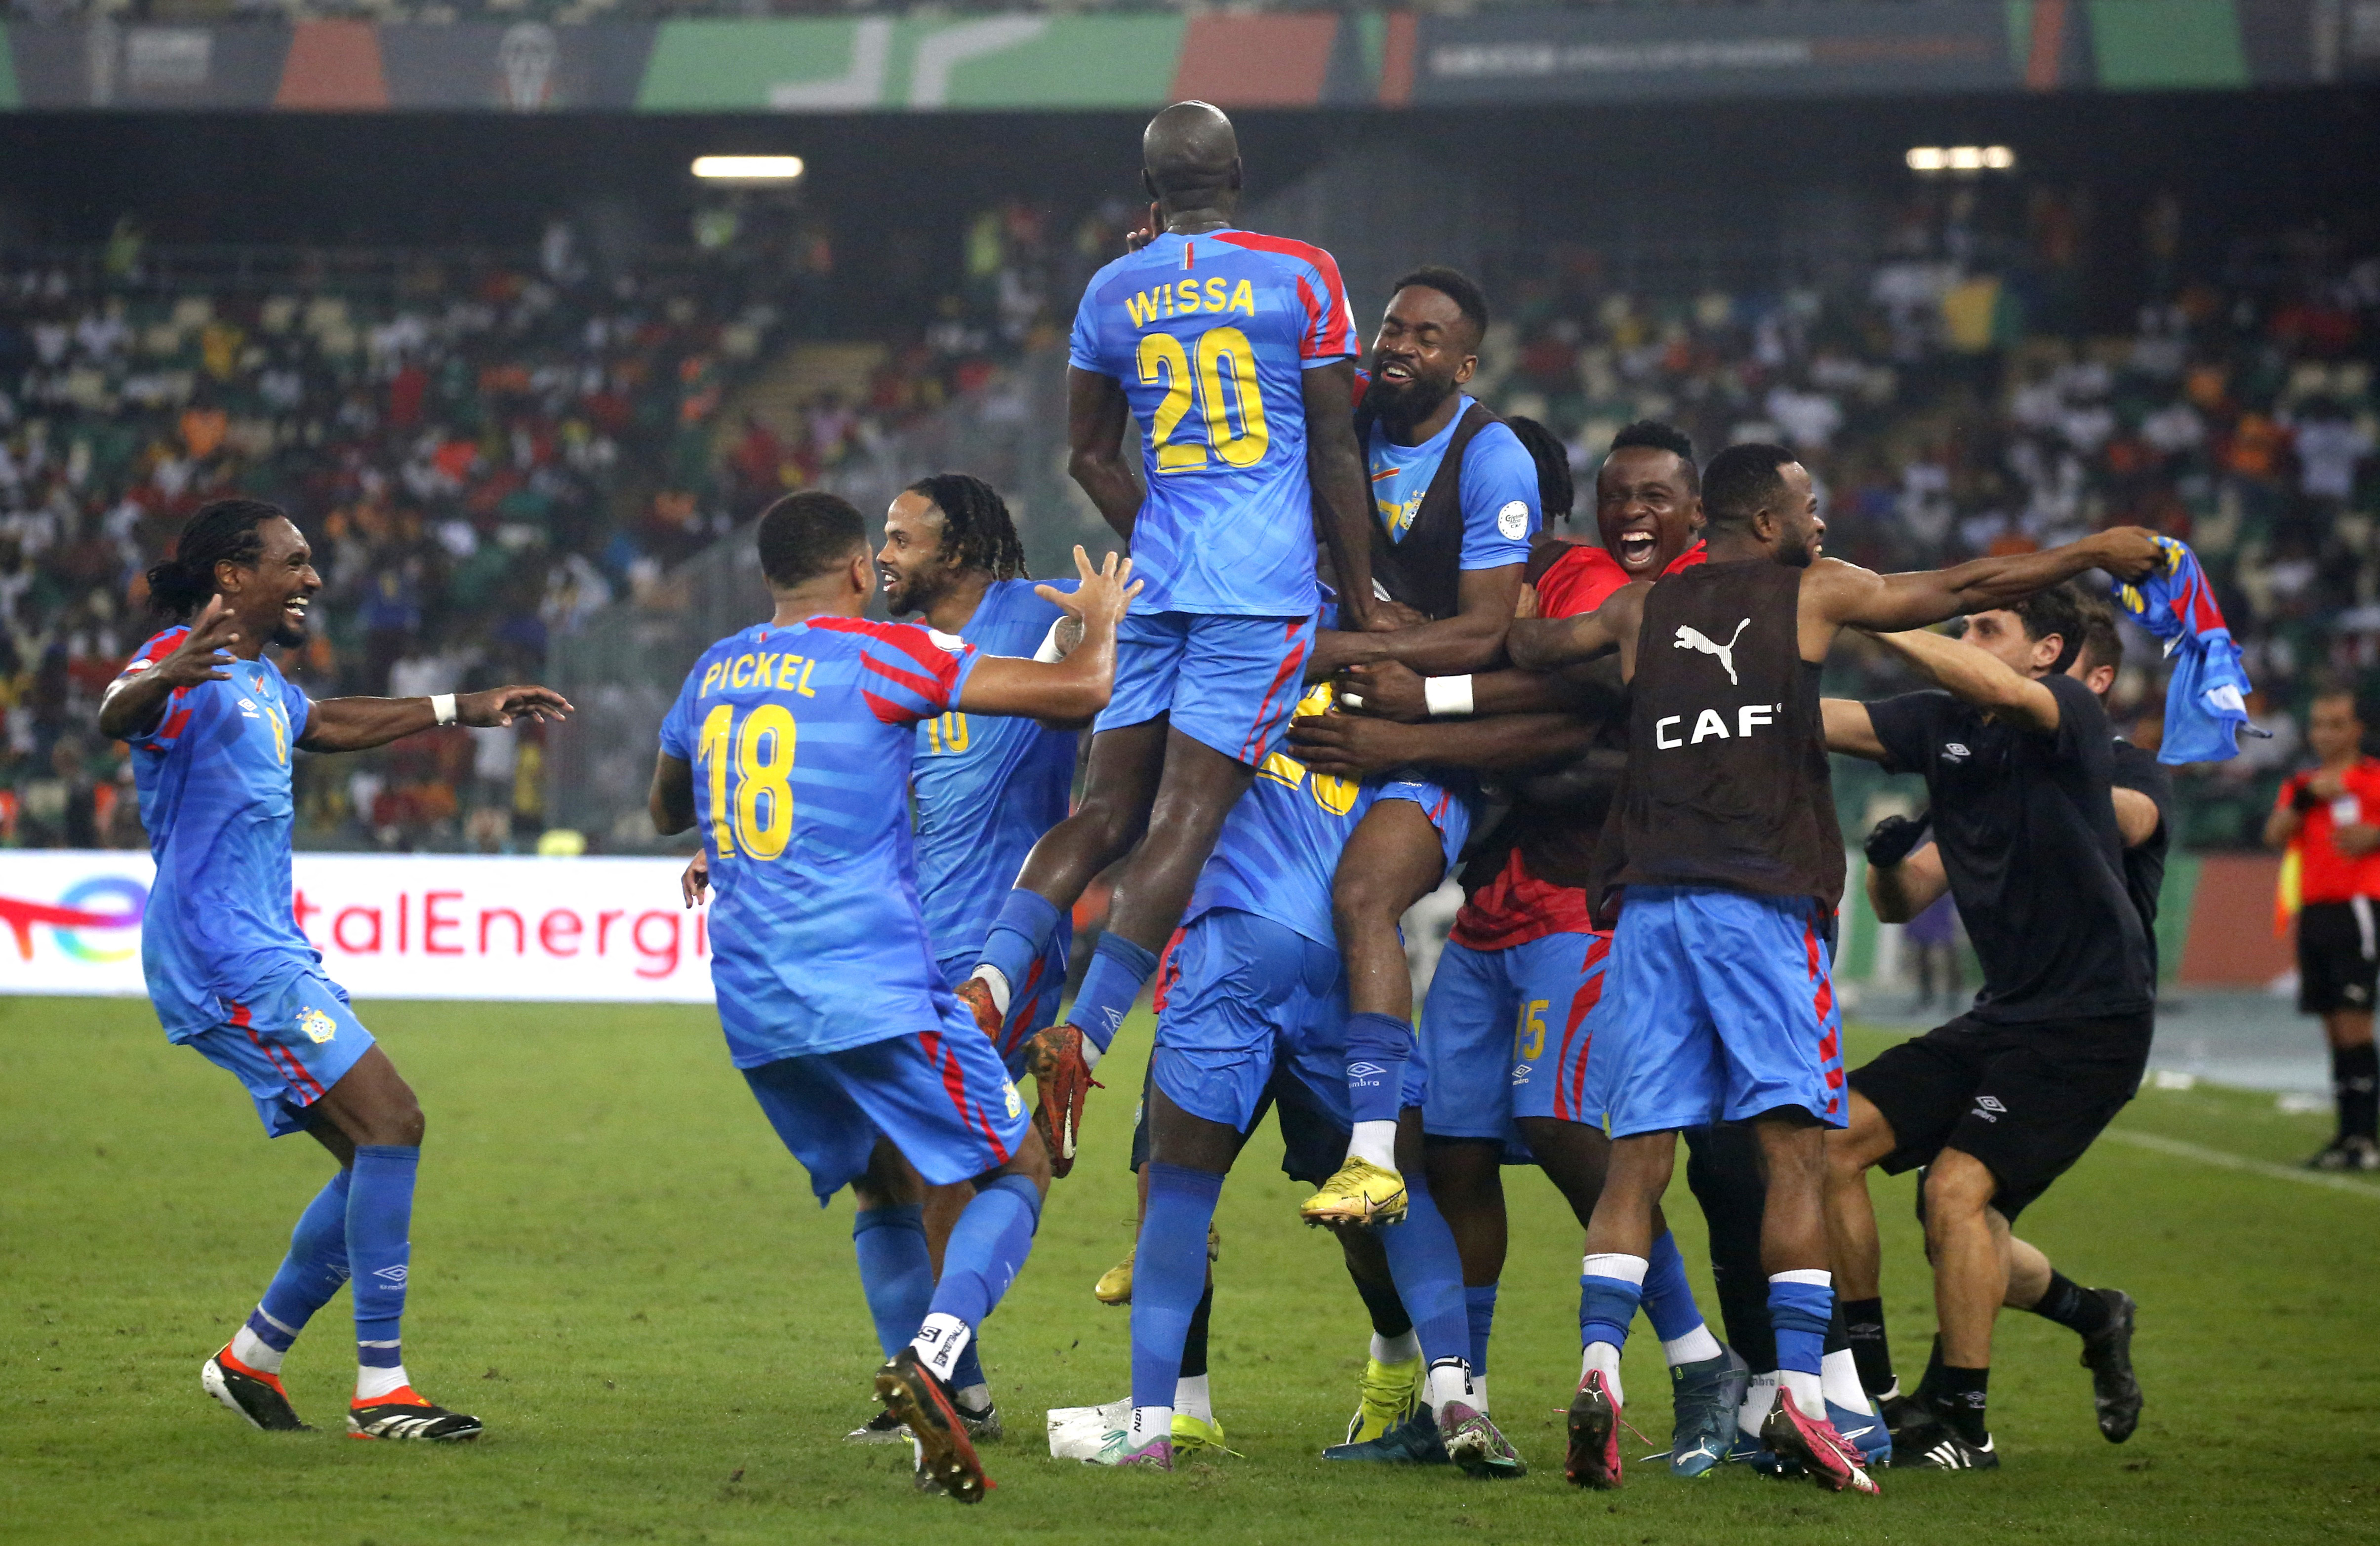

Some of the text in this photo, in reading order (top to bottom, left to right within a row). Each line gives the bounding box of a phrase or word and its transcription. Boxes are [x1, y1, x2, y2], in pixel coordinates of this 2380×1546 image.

[1125, 277, 1254, 328] WISSA
[1136, 326, 1269, 474] 20
[700, 652, 816, 699] PICKEL
[1656, 704, 1772, 750] CAF
[697, 704, 796, 861] 18
[1513, 999, 1550, 1063] 15
